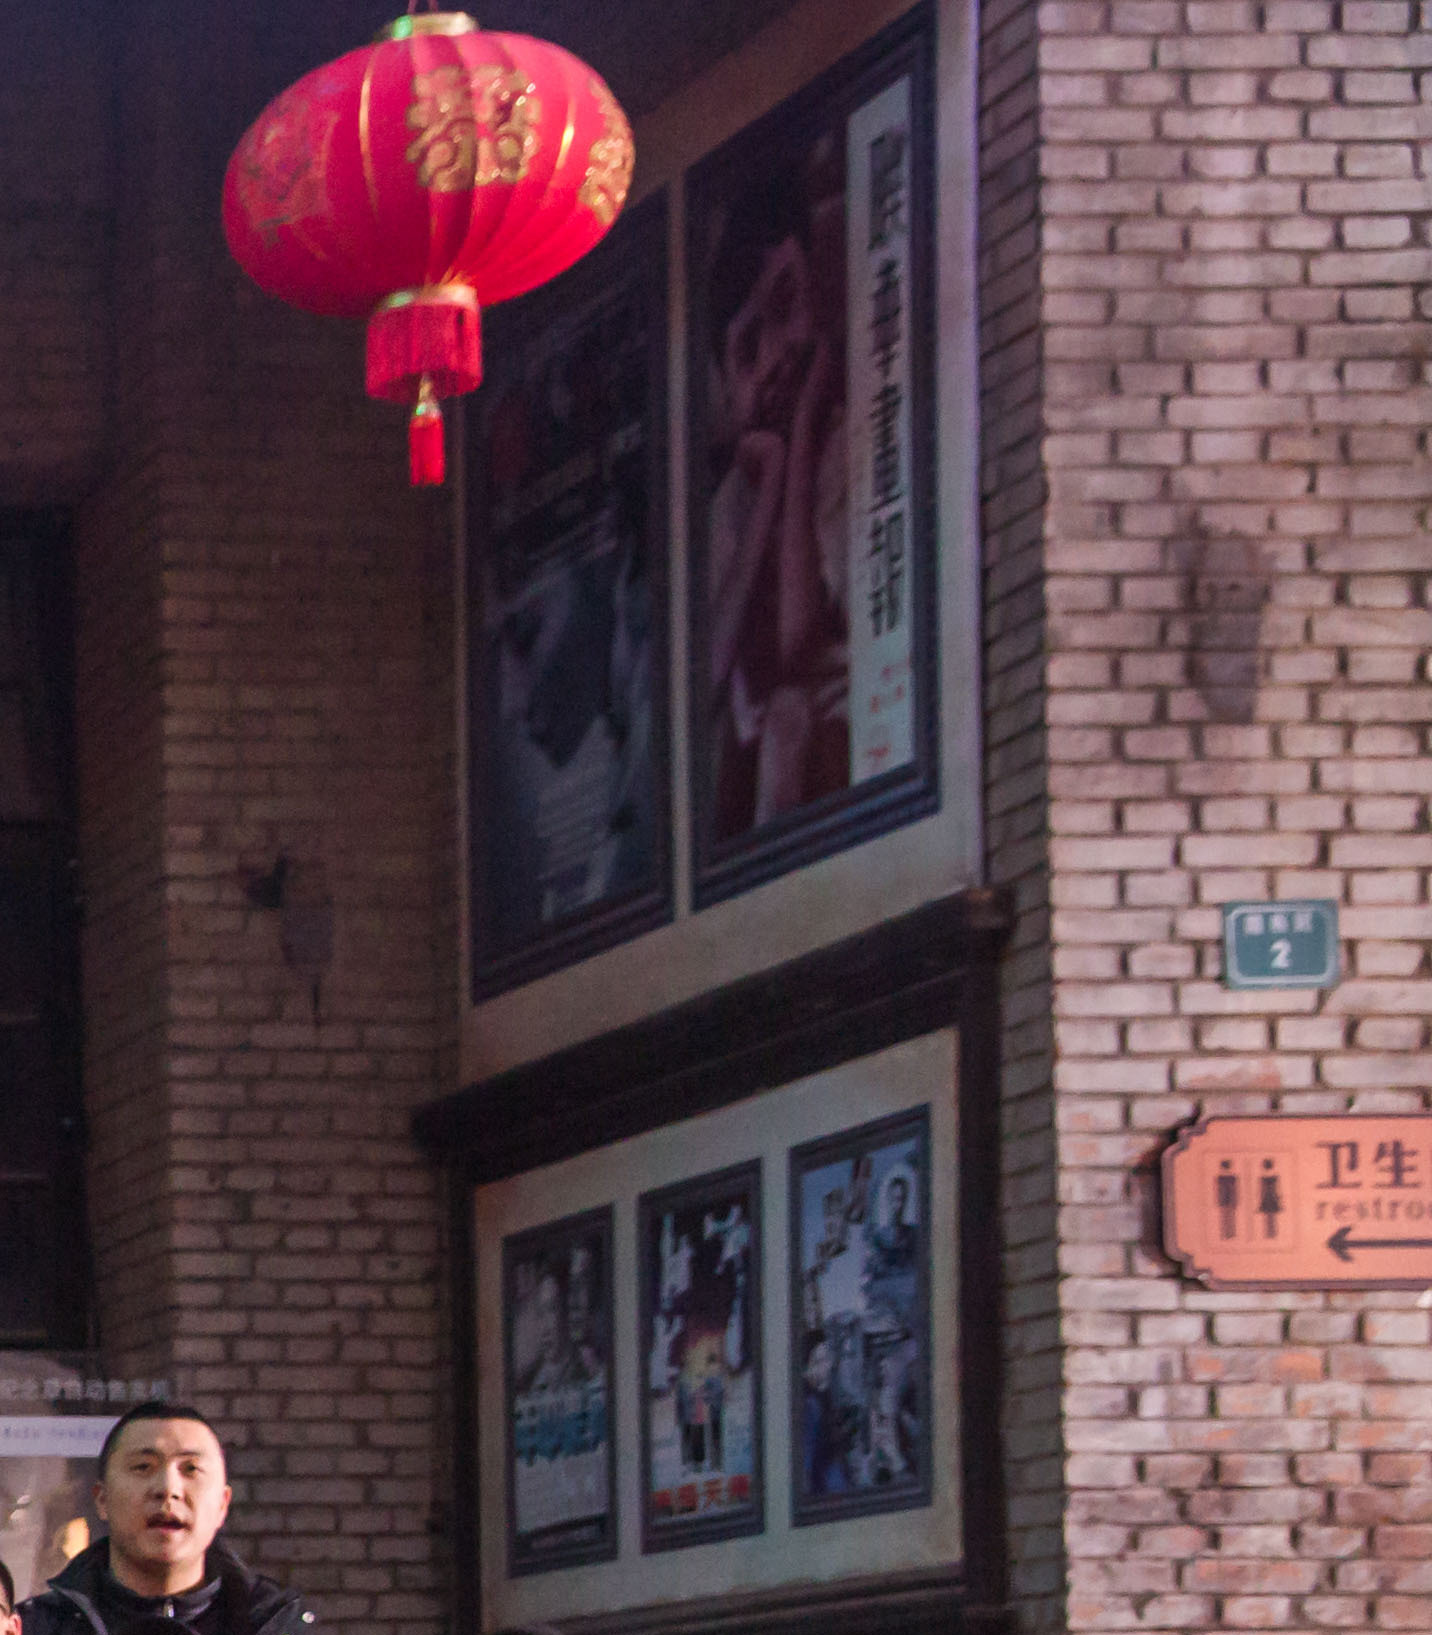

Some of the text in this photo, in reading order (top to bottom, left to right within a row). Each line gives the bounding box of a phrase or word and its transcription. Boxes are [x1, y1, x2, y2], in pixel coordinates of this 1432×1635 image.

[1270, 939, 1292, 969] 2
[1314, 1139, 1432, 1190] 卫生
[1314, 1197, 1432, 1222] restro
